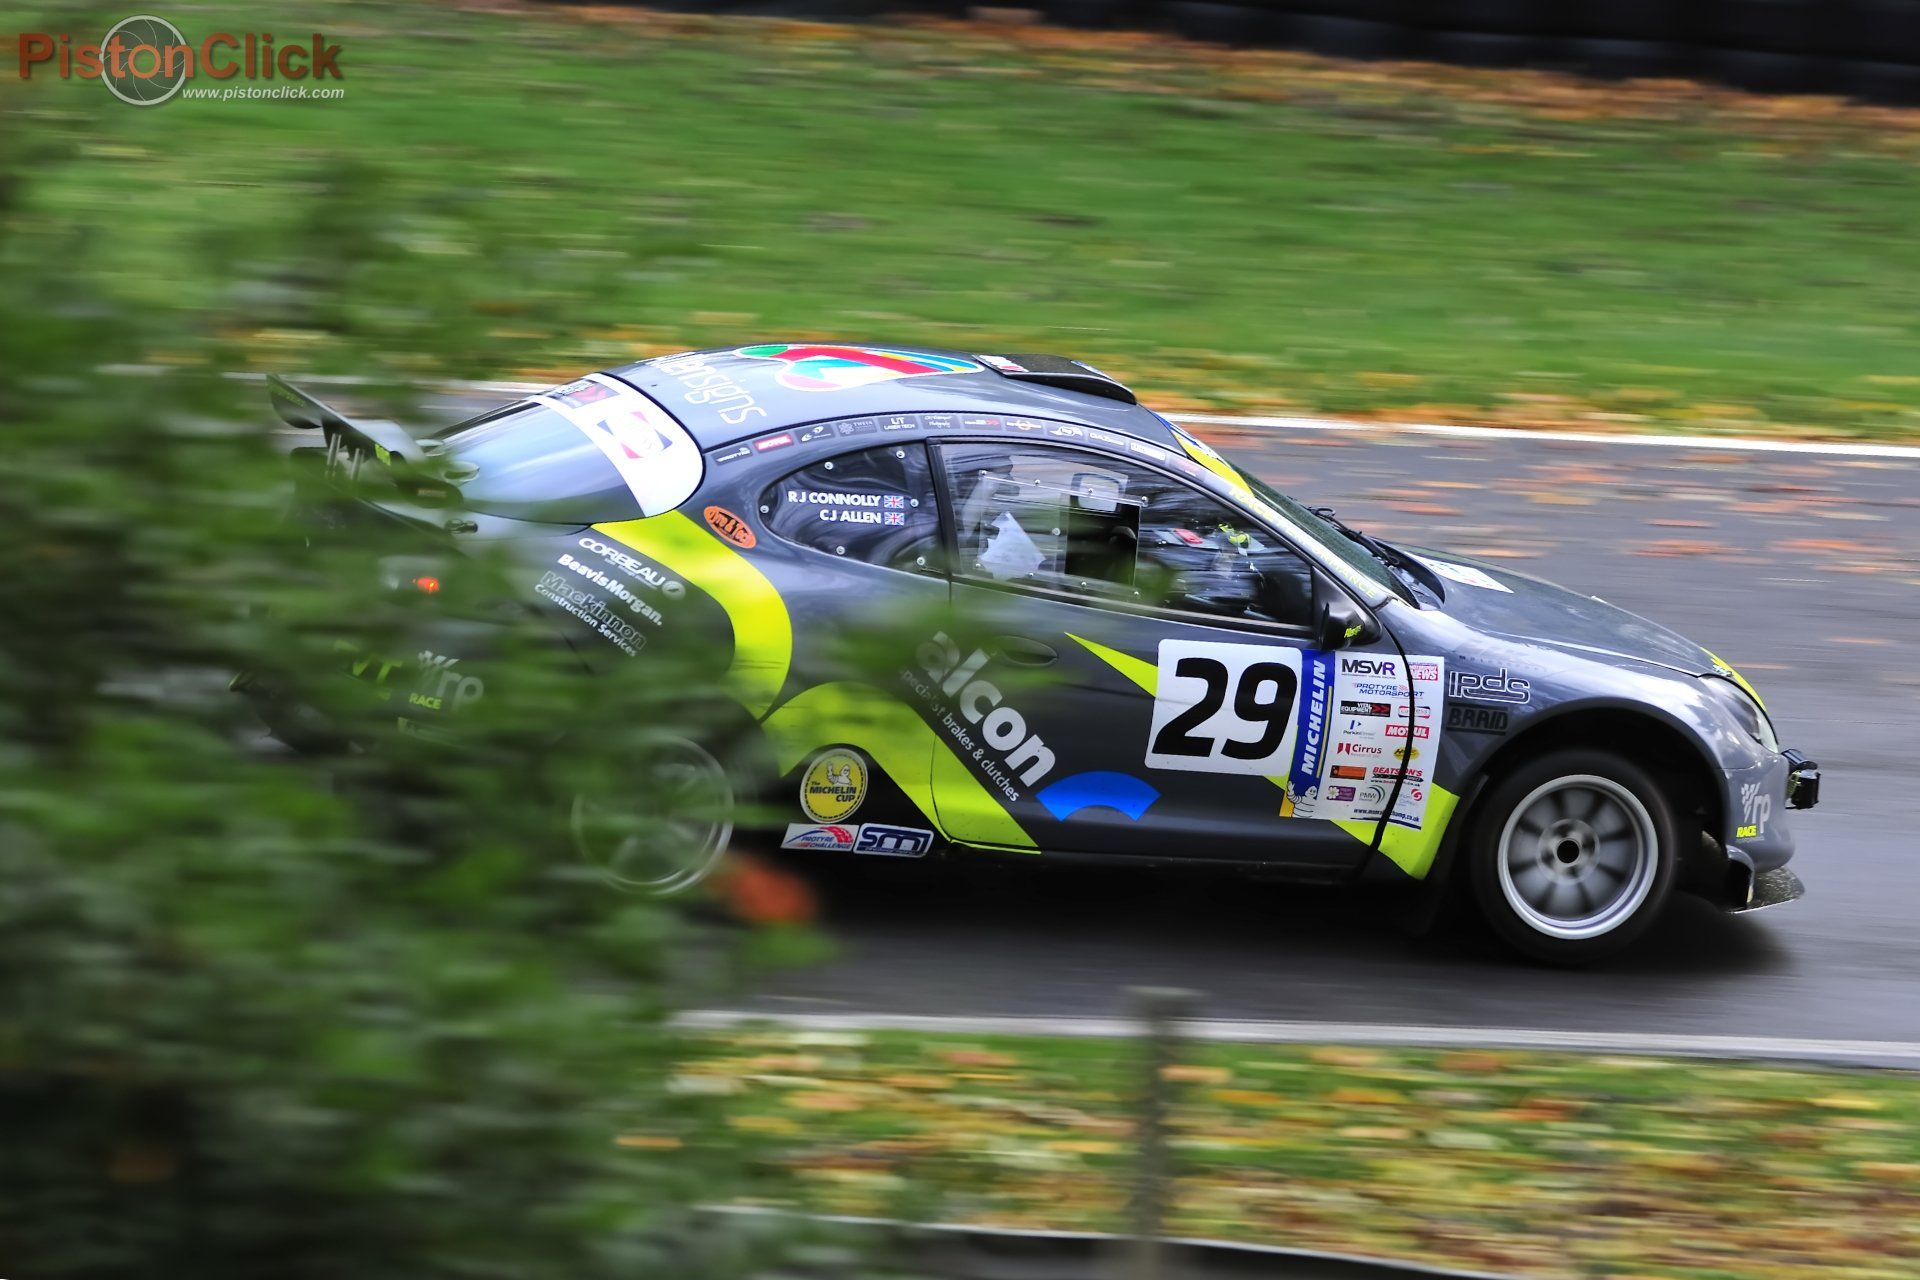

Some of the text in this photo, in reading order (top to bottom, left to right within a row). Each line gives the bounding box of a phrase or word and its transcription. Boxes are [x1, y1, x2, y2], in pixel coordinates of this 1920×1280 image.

[809, 492, 881, 507] CONNOLLY
[842, 511, 881, 523] ALLEN
[578, 537, 666, 586] CORBEAU
[534, 583, 637, 657] Construction Services
[1341, 658, 1396, 676] MSVR
[1356, 683, 1398, 691] PROTYRE
[409, 692, 442, 710] RACE
[915, 630, 1056, 787] alcon
[1152, 657, 1298, 760] 29
[1301, 659, 1326, 775] MICHELIN
[1448, 707, 1509, 731] BRAID
[942, 712, 974, 751] brakes
[972, 748, 985, 762] &
[981, 758, 1020, 802] clutches
[1352, 744, 1382, 754] Cirrus
[809, 786, 857, 795] MICHELIN
[835, 794, 855, 803] CUP
[809, 842, 852, 850] CHALLENGE
